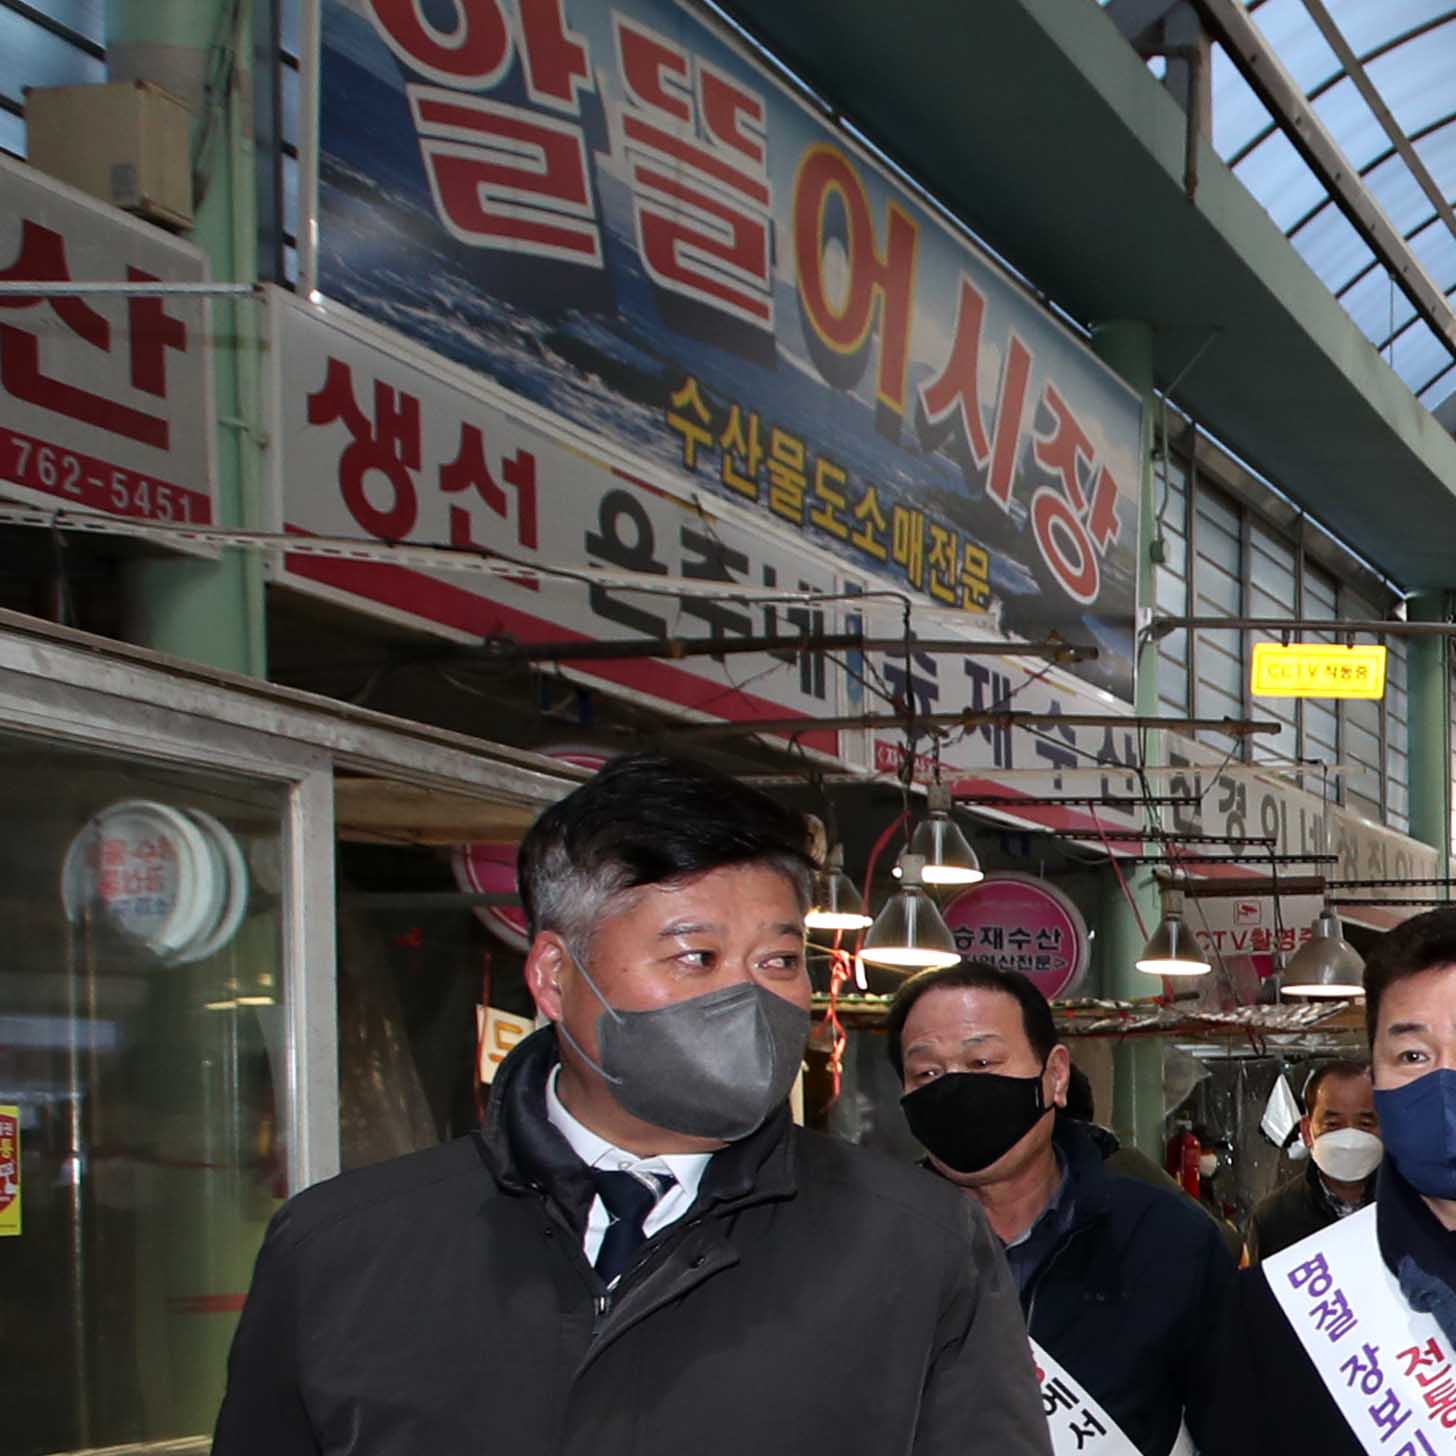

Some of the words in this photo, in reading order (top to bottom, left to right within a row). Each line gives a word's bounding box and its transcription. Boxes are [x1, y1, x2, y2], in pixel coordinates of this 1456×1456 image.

[11, 437, 193, 524] 762-5451
[306, 355, 540, 552] 생선
[1287, 1250, 1359, 1343] 명절
